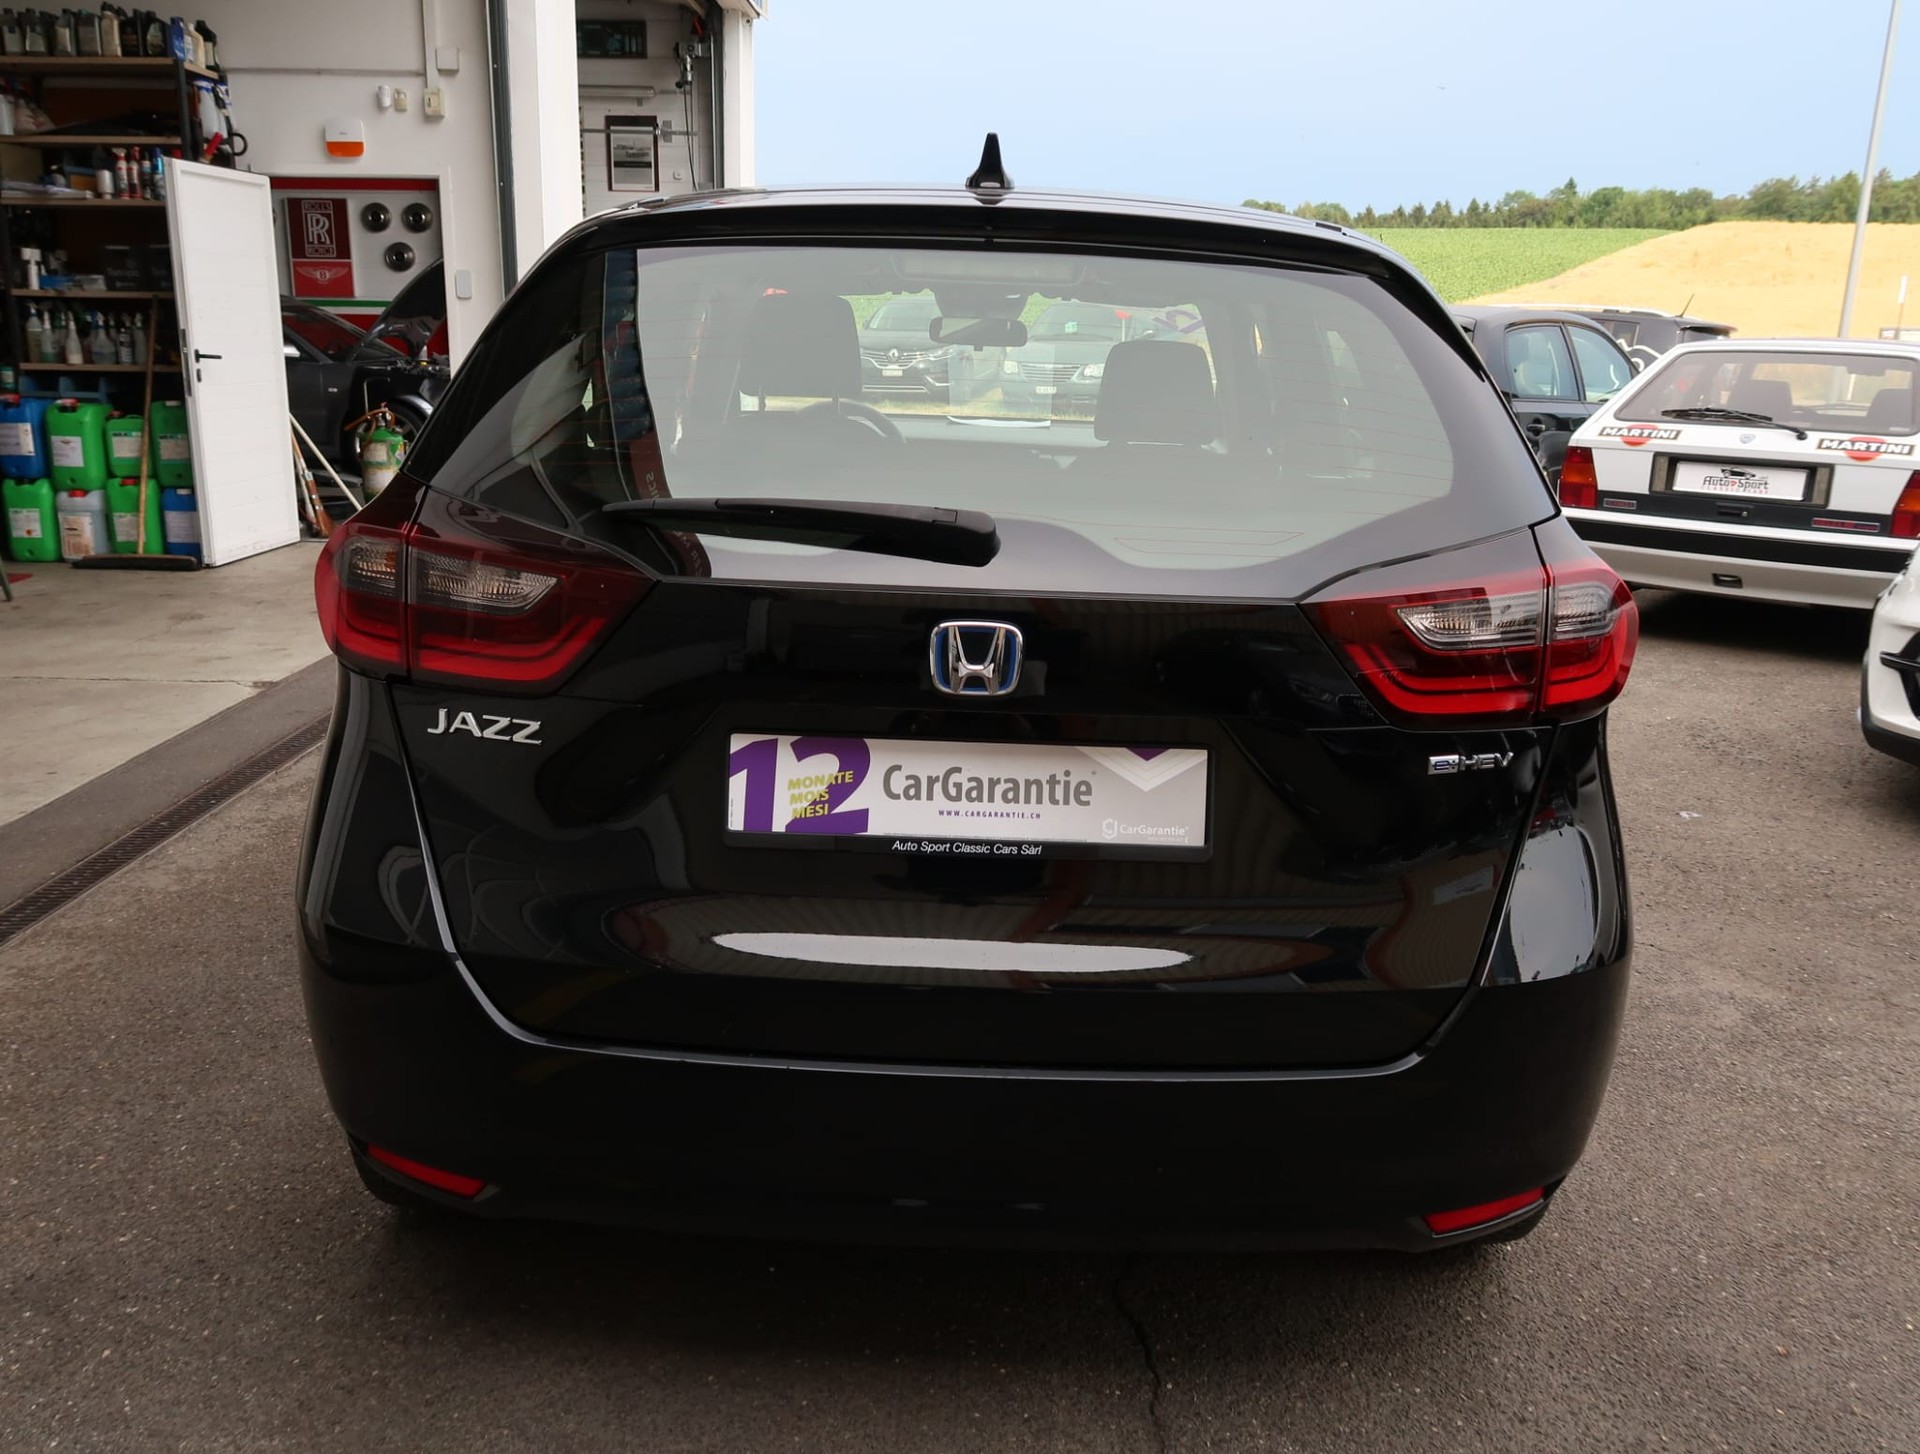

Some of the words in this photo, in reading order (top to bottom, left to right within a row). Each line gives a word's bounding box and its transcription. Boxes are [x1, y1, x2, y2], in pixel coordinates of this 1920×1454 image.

[1602, 428, 1677, 439] MARTINI
[1821, 440, 1910, 454] MARTINI
[1703, 476, 1730, 486] Auto
[1738, 479, 1769, 491] Sport
[427, 708, 542, 744] JAZZ
[729, 735, 870, 833] 12
[787, 771, 854, 790] MONATE
[883, 764, 1093, 806] CarGarantie
[789, 789, 830, 805] MOIS
[791, 804, 829, 819] MESI
[938, 809, 1041, 820] WWW.CARGARANTIE.CH
[1119, 825, 1185, 836] CarGarantie
[892, 840, 918, 851] Auto
[920, 841, 950, 853] Sport
[952, 842, 991, 854] Classic
[993, 843, 1018, 854] Cars
